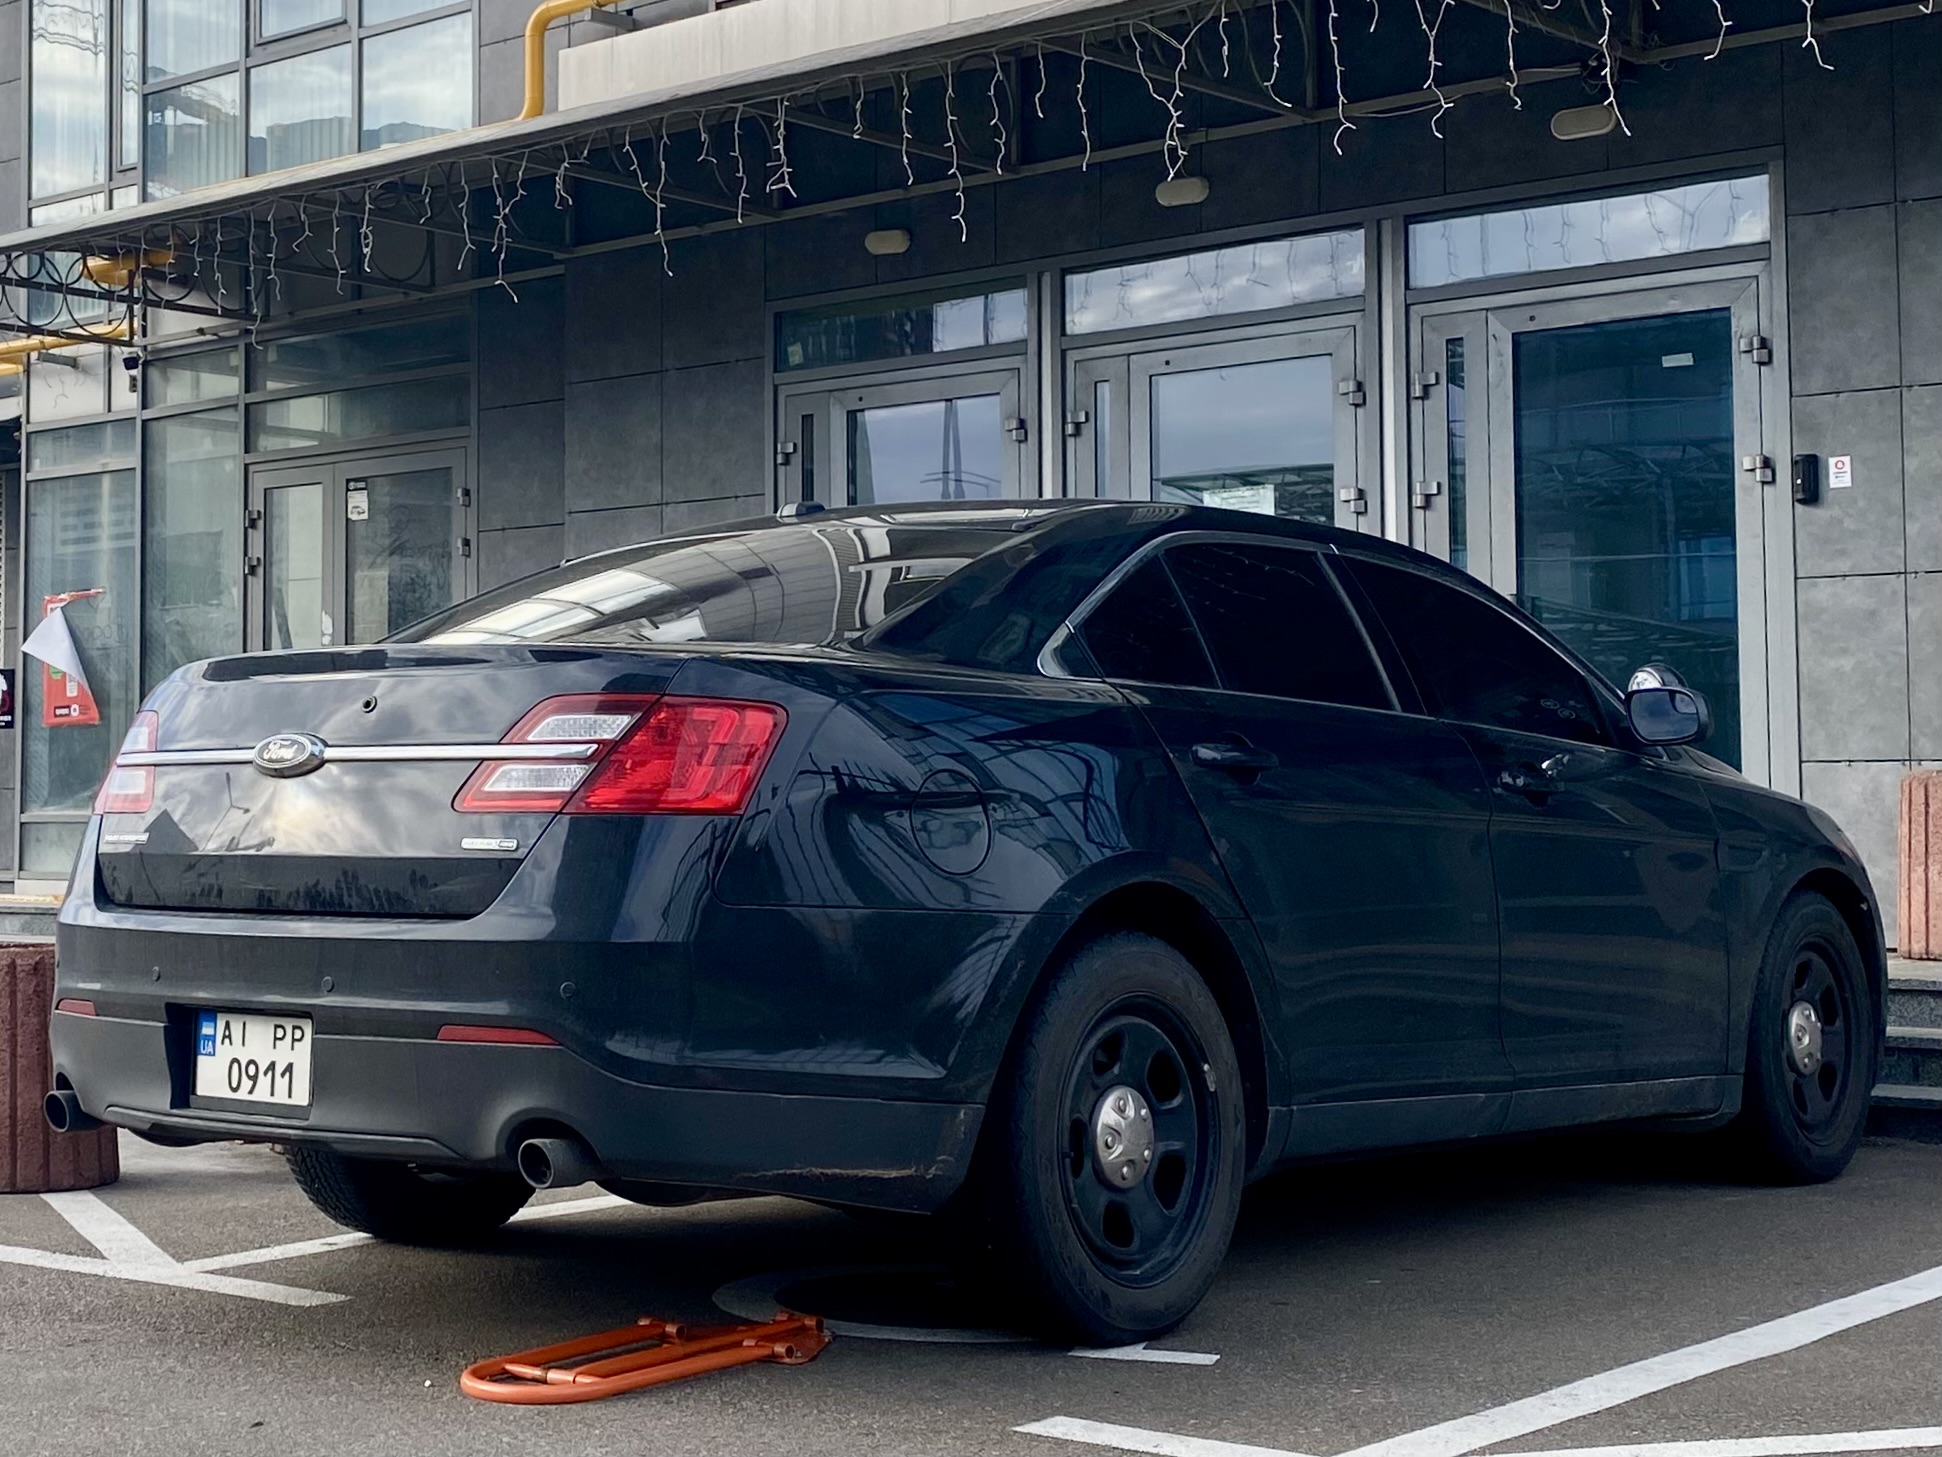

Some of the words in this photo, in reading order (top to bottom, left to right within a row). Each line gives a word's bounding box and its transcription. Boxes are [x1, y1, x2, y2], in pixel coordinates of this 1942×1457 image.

[264, 739, 298, 759] Ford
[200, 1040, 214, 1055] UA
[273, 1024, 304, 1051] PP
[228, 1057, 294, 1099] 0911
